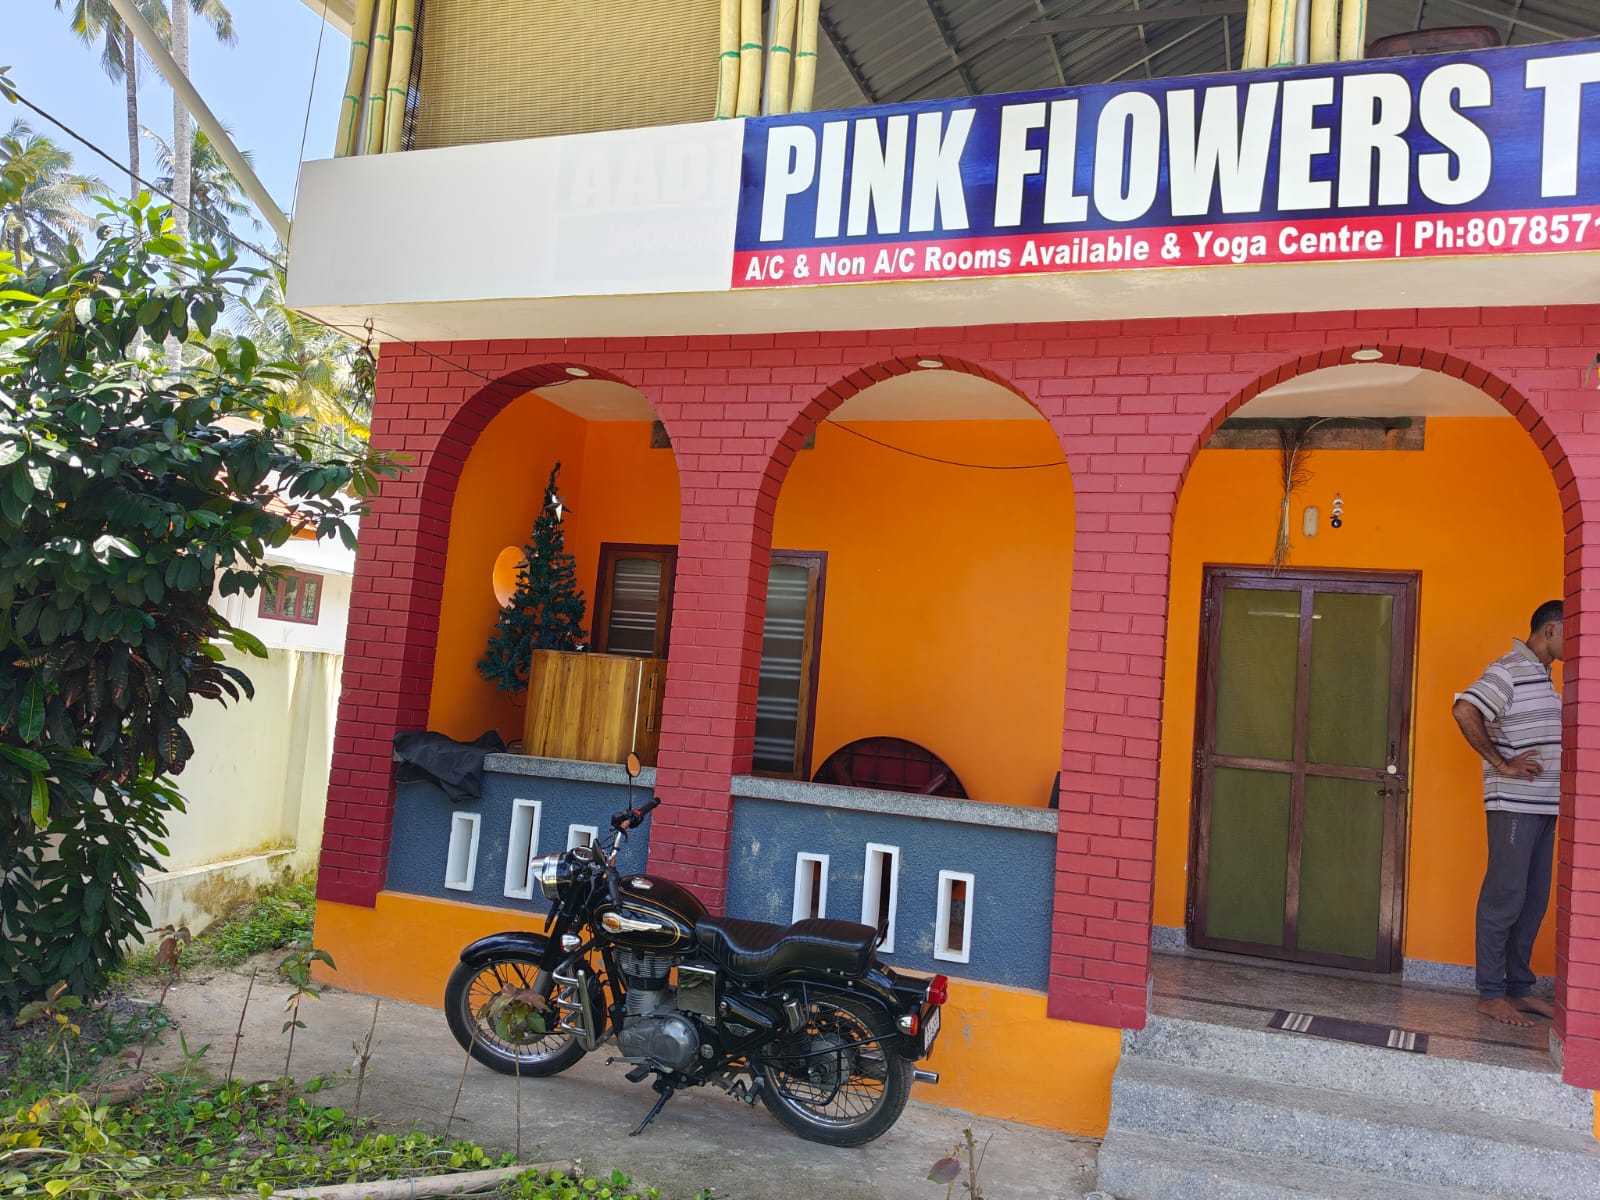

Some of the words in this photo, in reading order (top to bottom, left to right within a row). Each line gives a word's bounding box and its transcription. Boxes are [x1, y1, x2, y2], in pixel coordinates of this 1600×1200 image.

[759, 108, 976, 242] PINK
[994, 63, 1492, 228] FLOWERS
[745, 255, 785, 281] A/C
[793, 253, 810, 279] &
[819, 251, 866, 277] Non
[873, 247, 916, 275] A/C
[924, 246, 1012, 272] Rooms
[1020, 235, 1150, 267] Available
[1161, 232, 1182, 260] &
[1192, 231, 1267, 264] Yoga
[1278, 226, 1384, 255] Centre
